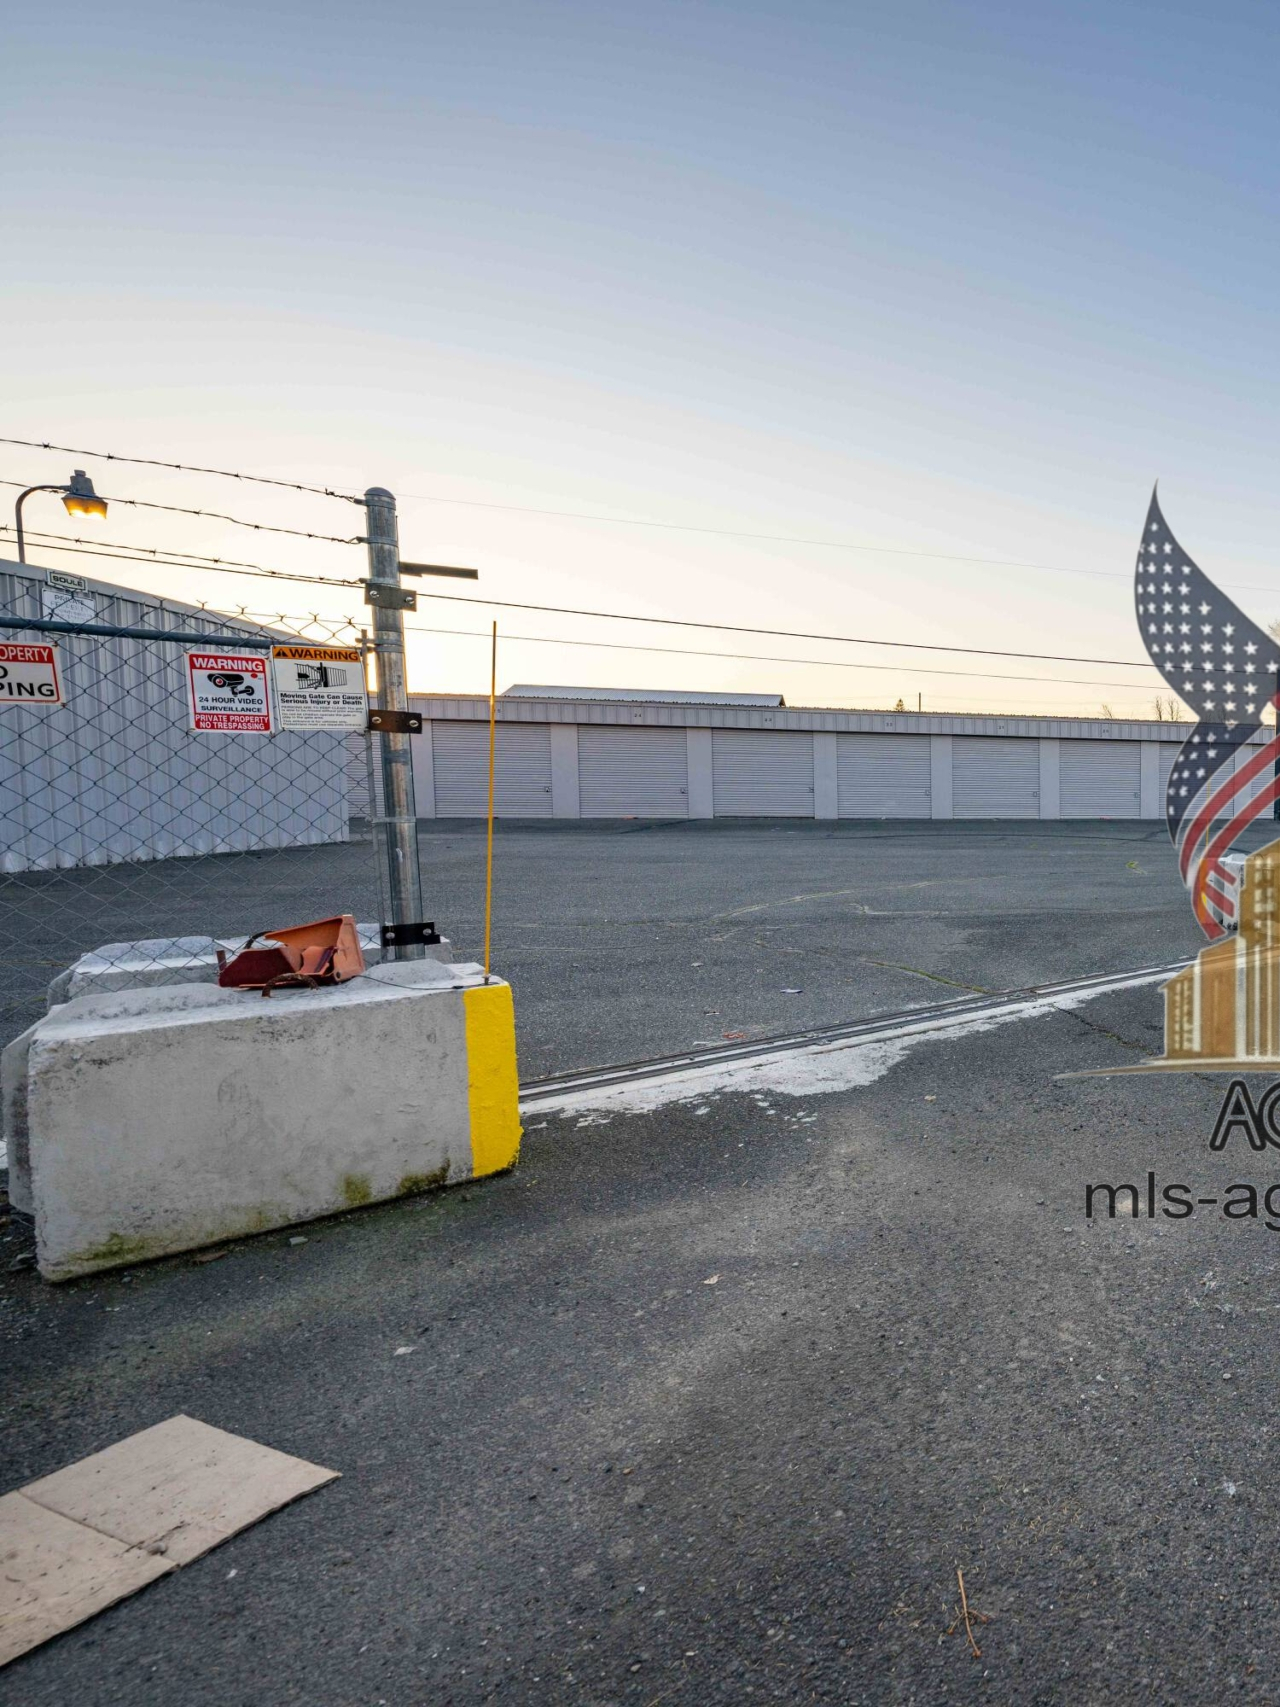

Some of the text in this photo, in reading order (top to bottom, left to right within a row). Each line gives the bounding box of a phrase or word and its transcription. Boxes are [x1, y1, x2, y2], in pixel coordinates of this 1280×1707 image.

[289, 648, 358, 660] WARNING
[192, 657, 263, 671] WARNING
[211, 696, 235, 704] HOUR
[201, 705, 263, 713] SURVEILLANCE
[195, 714, 269, 723] PRIVATE PROPERTY
[212, 721, 265, 730] TRESPASSING
